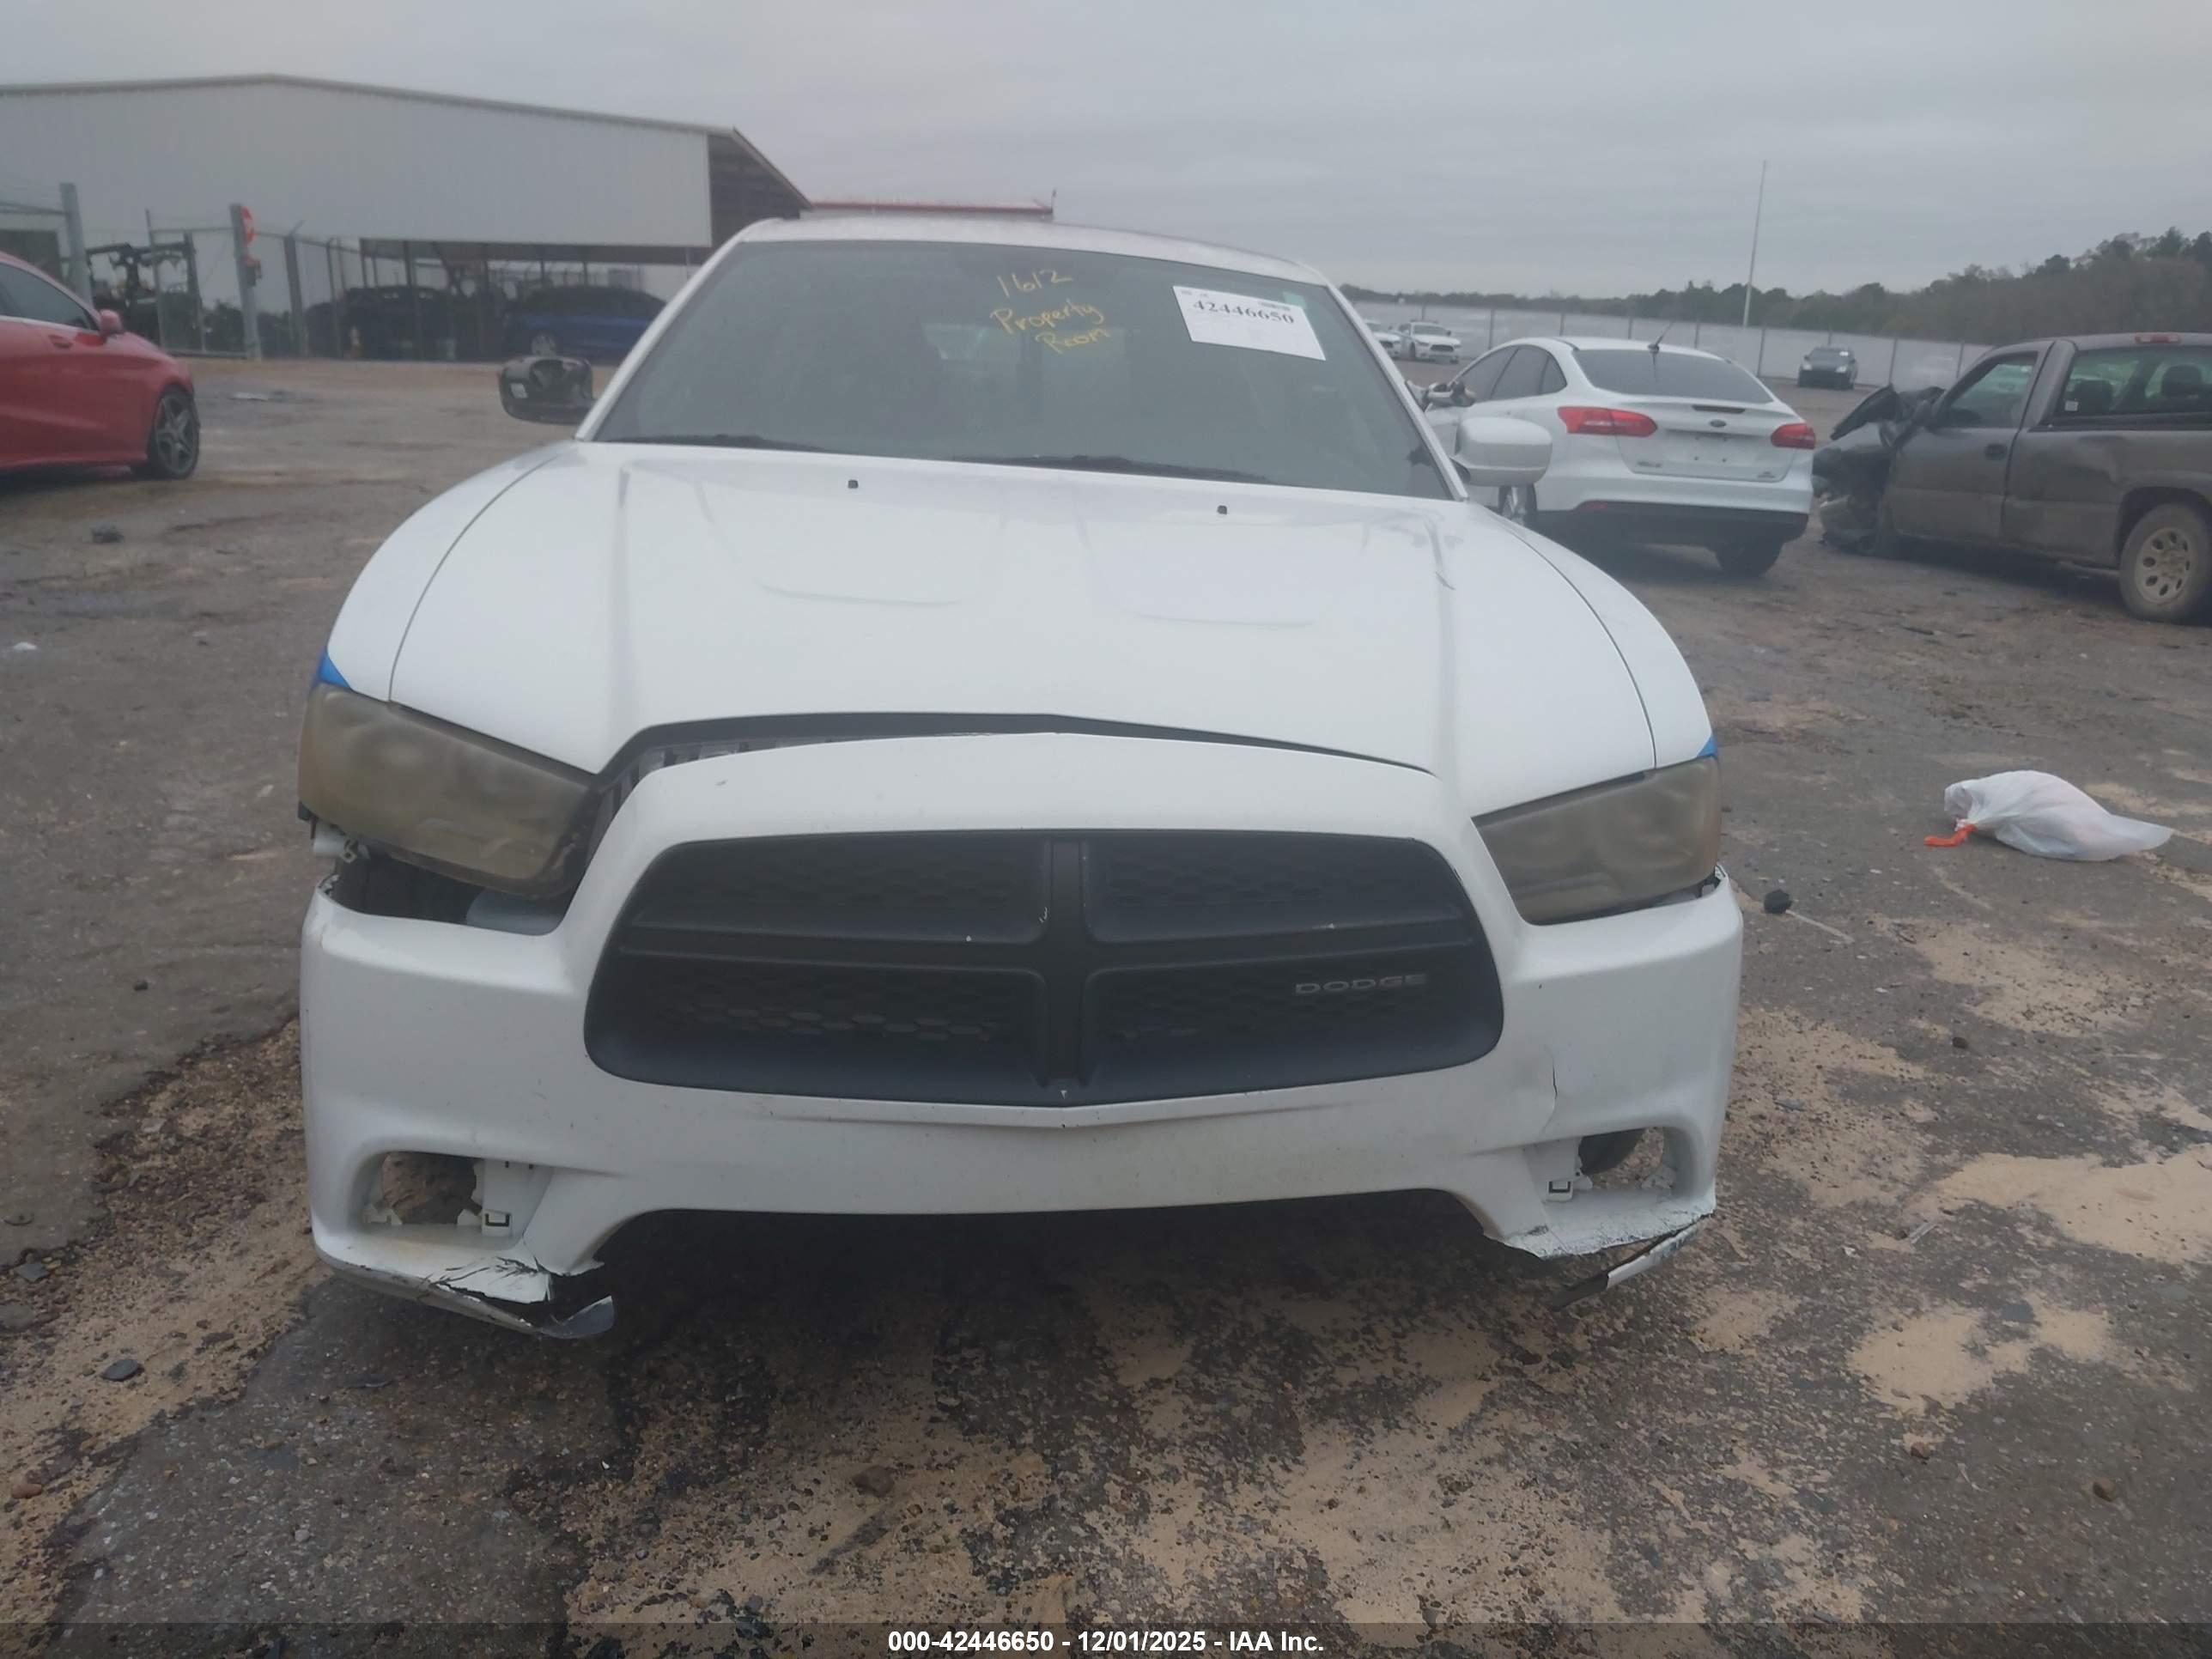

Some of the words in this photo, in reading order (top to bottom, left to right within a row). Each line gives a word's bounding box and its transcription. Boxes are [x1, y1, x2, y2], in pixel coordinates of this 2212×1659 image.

[996, 269, 1073, 297] 1612
[989, 298, 1104, 334] Property
[1193, 300, 1295, 325] 42446650
[1295, 974, 1427, 994] DODGE
